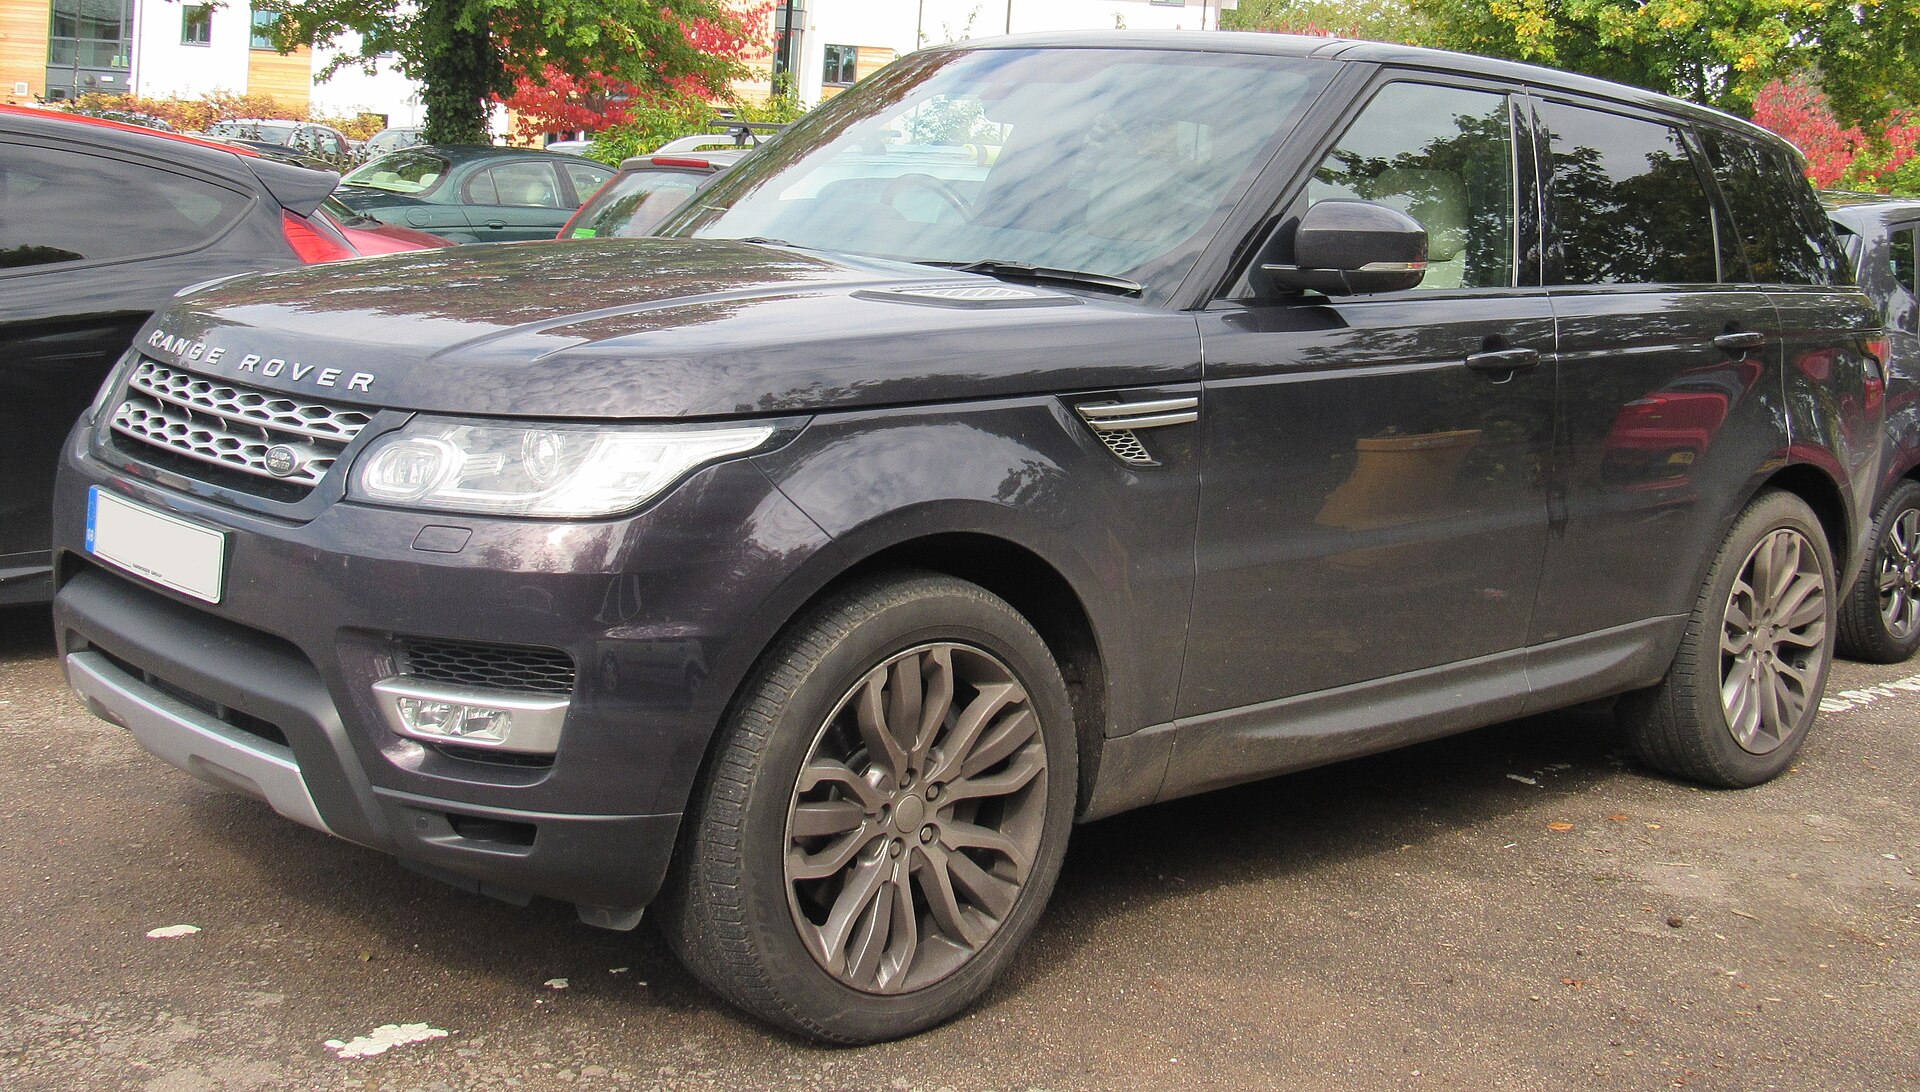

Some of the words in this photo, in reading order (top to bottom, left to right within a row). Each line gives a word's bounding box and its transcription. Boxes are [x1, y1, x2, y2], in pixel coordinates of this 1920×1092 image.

[147, 328, 226, 365] RANGE
[238, 353, 375, 392] ROVER
[271, 450, 288, 460] LAND
[270, 459, 290, 470] ROVER
